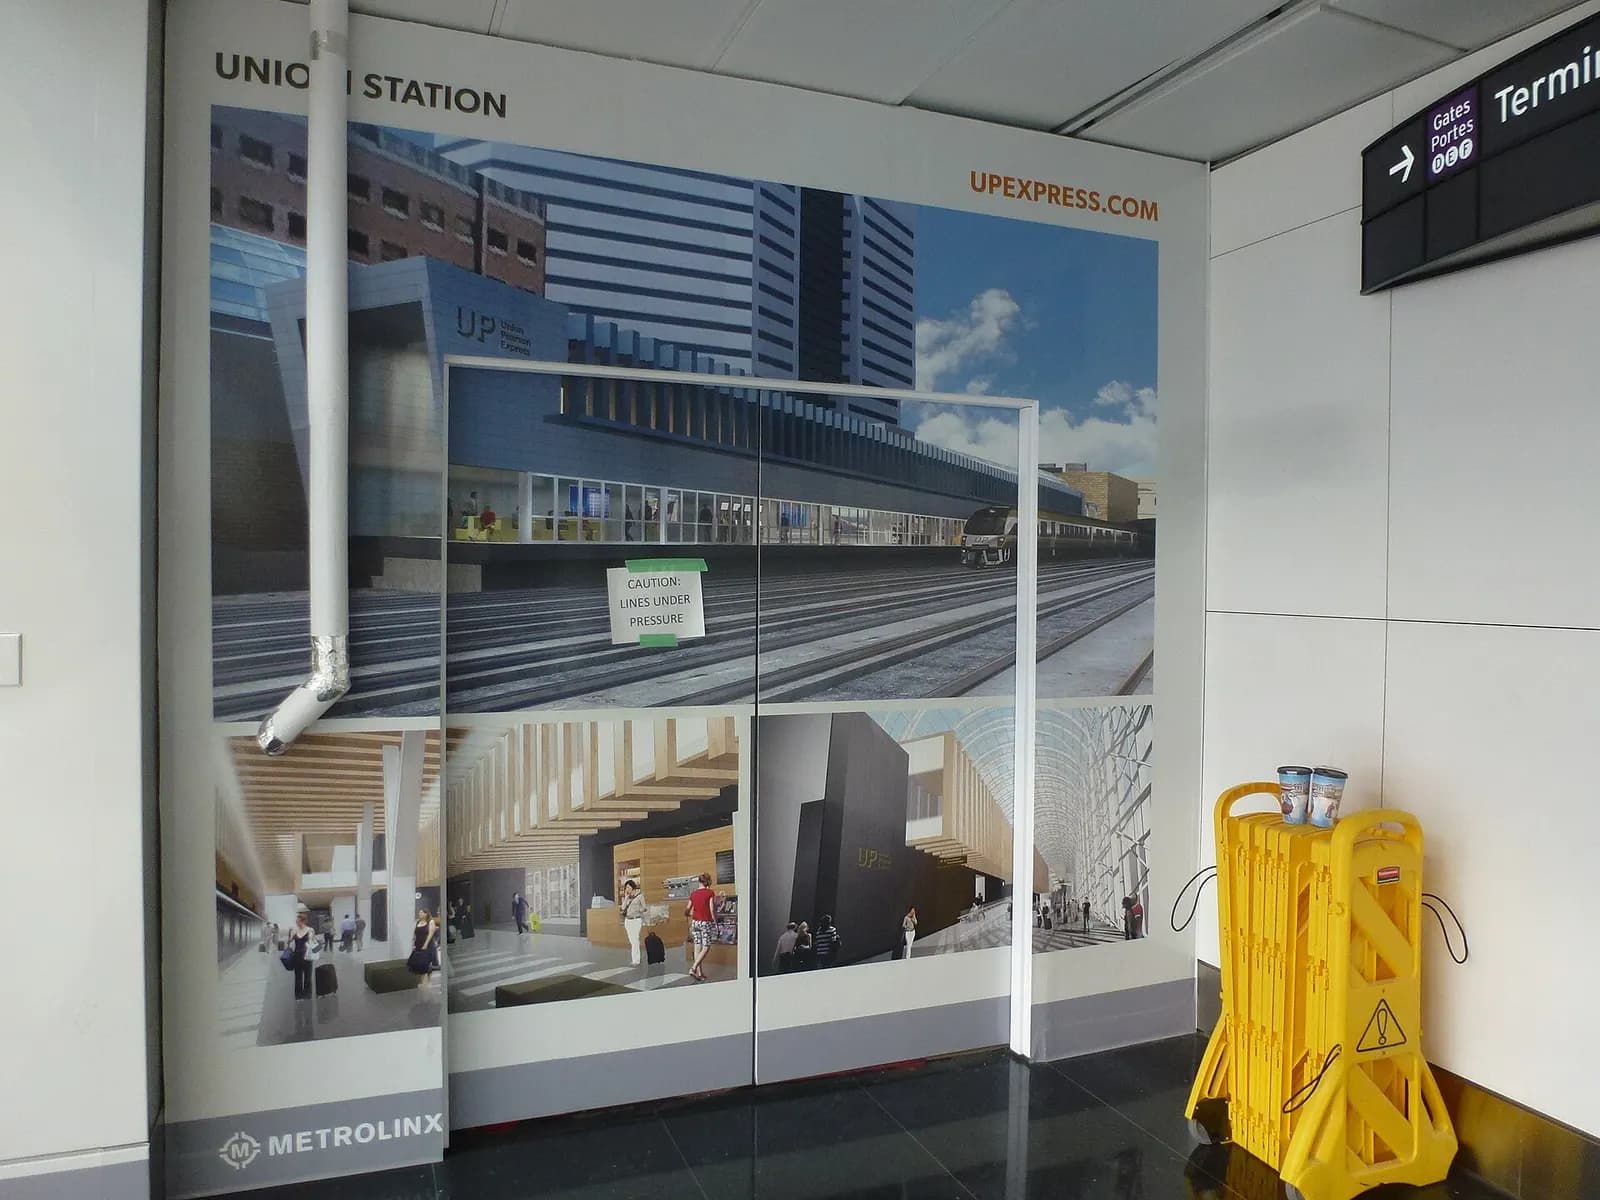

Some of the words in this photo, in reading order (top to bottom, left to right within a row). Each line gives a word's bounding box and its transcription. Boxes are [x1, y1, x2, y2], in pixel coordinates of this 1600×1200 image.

[215, 52, 352, 96] UNIO
[362, 73, 507, 118] STATION
[1433, 100, 1471, 131] Gates
[1431, 118, 1474, 152] Portes
[970, 170, 1159, 222] UPEXPRESS.COM
[457, 306, 496, 343] UP
[627, 576, 681, 590] CAUTION:
[620, 597, 651, 609] LINES
[653, 594, 691, 607] UNDER
[630, 613, 684, 627] PRESSURE
[268, 1112, 443, 1157] METROLINX
